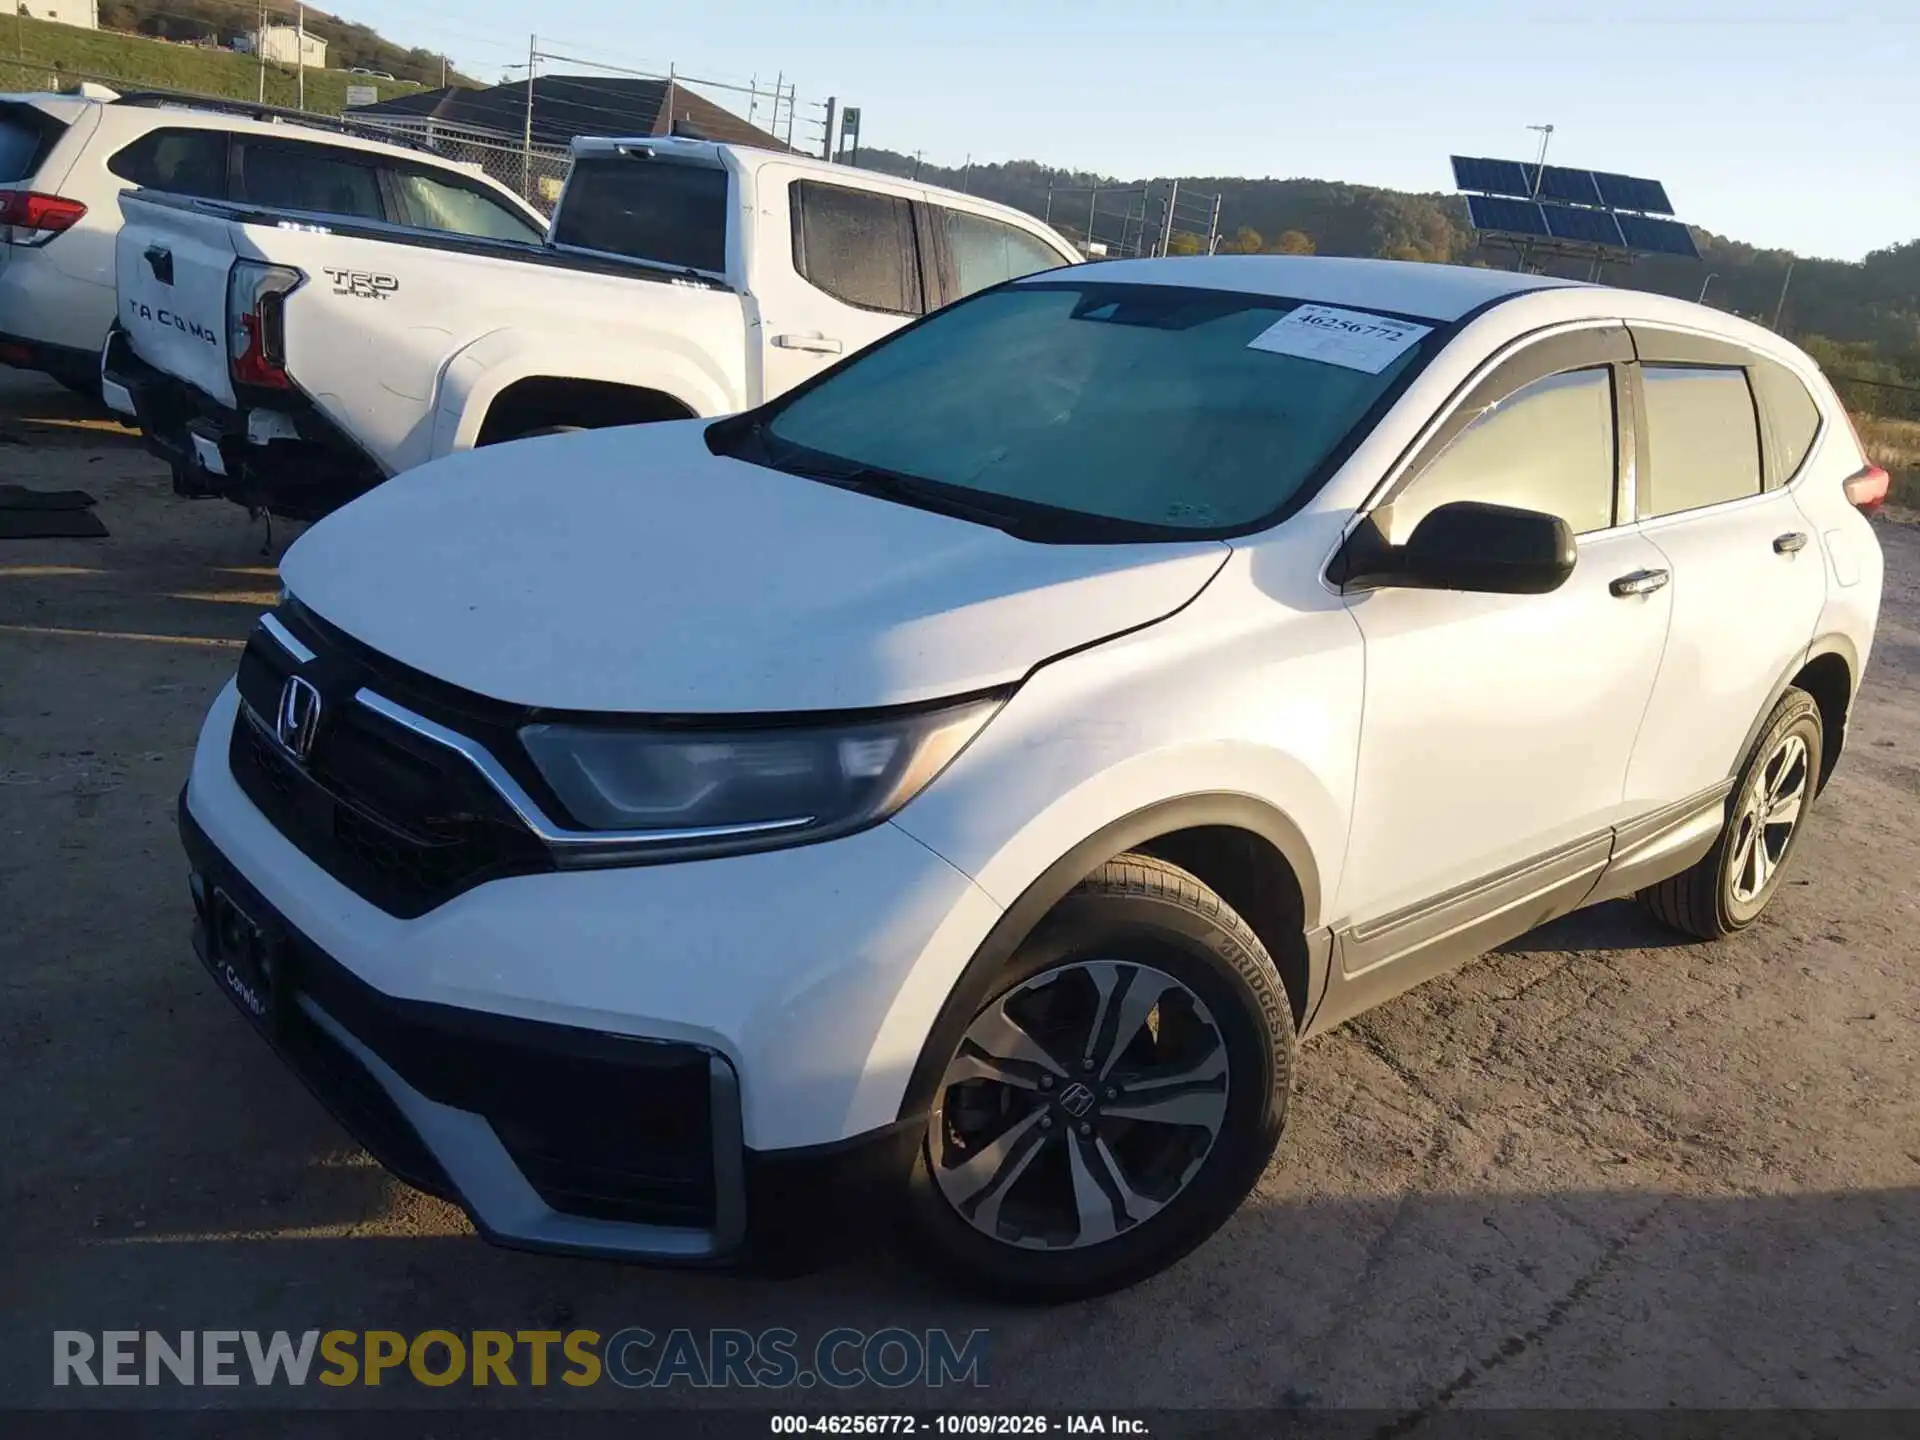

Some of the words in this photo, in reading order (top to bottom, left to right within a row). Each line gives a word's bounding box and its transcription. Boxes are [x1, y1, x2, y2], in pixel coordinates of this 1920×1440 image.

[323, 266, 399, 291] TRD
[332, 287, 390, 300] SPORT
[129, 300, 217, 346] TACOMA
[1298, 313, 1403, 341] 46256772
[1220, 935, 1285, 1100] BRIDGESTONE
